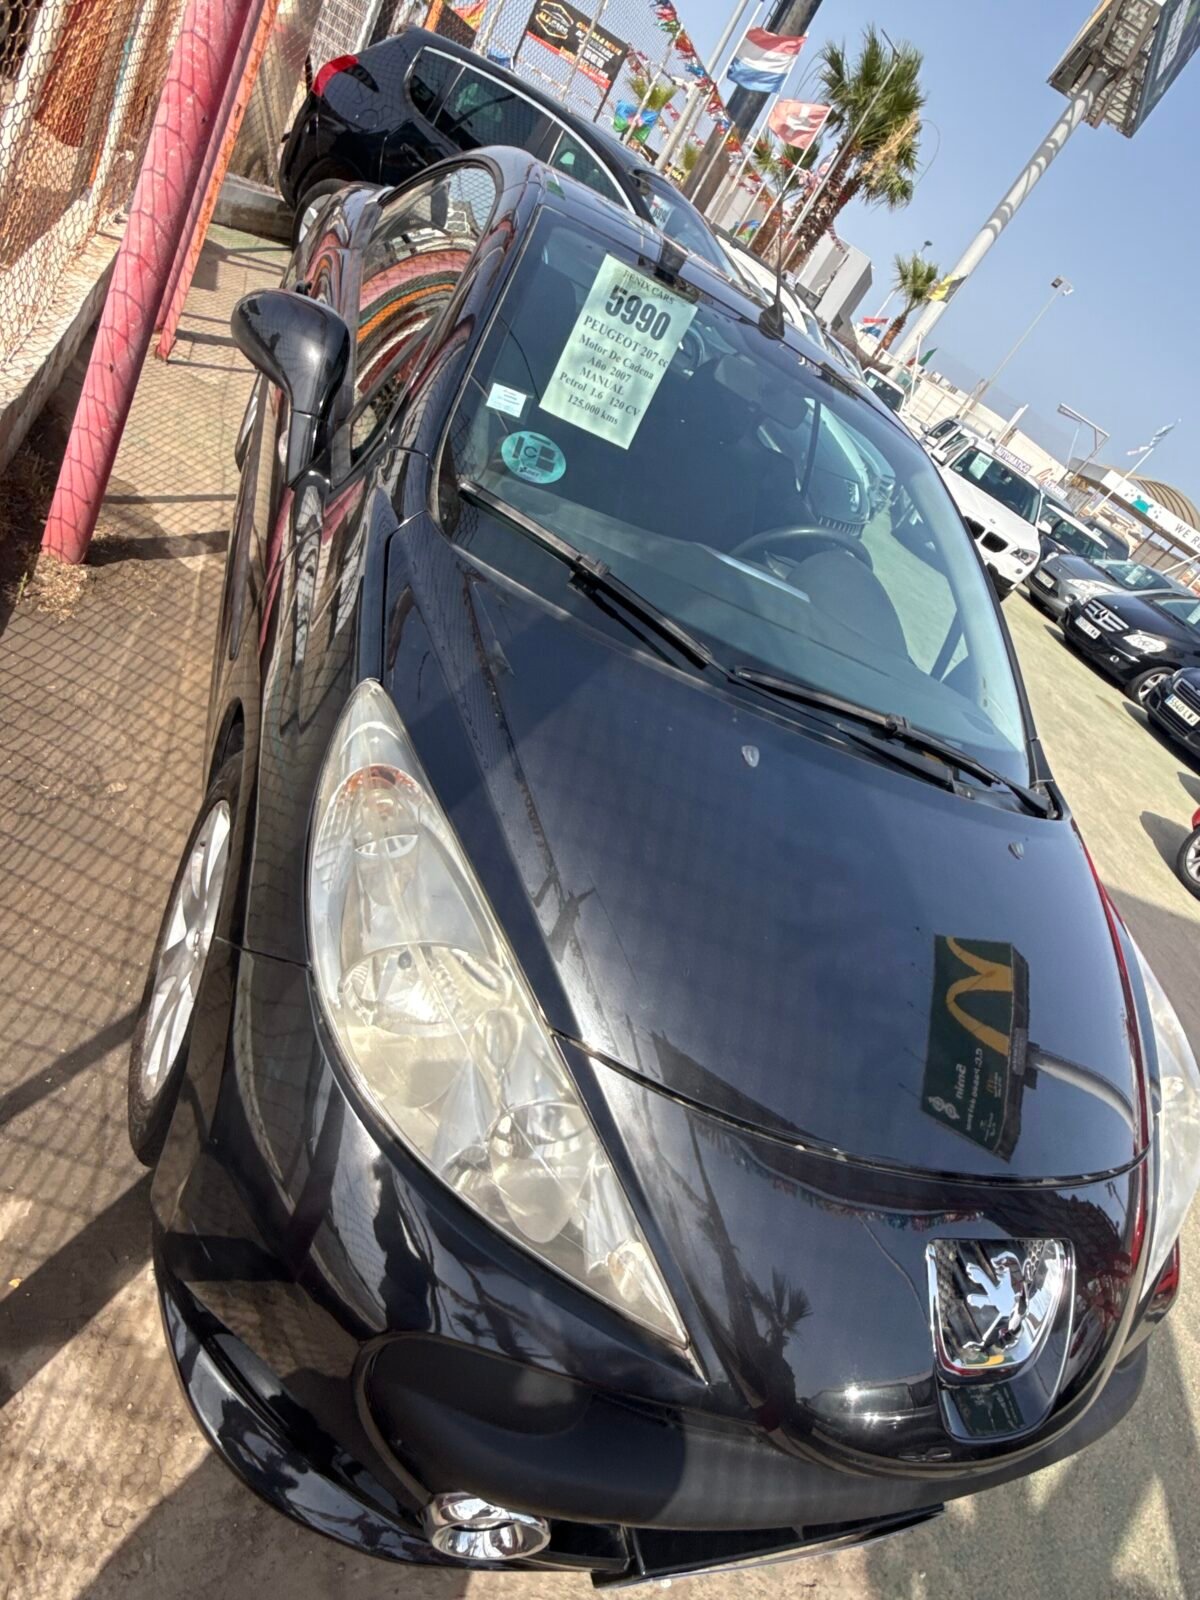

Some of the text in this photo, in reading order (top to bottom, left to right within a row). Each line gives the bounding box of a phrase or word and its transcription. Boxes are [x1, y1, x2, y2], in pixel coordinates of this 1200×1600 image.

[623, 269, 674, 304] FENIX CARS
[605, 284, 672, 341] 5990
[583, 315, 641, 352] PEUGEOT
[640, 344, 659, 362] 207
[579, 334, 654, 380] Motor De Cadena
[587, 356, 632, 383] Año 2007
[559, 371, 641, 417] Petrol 1.6 120 CV
[580, 367, 624, 395] MANUAL
[567, 394, 619, 425] 125.000 kms
[1174, 523, 1192, 539] WE
